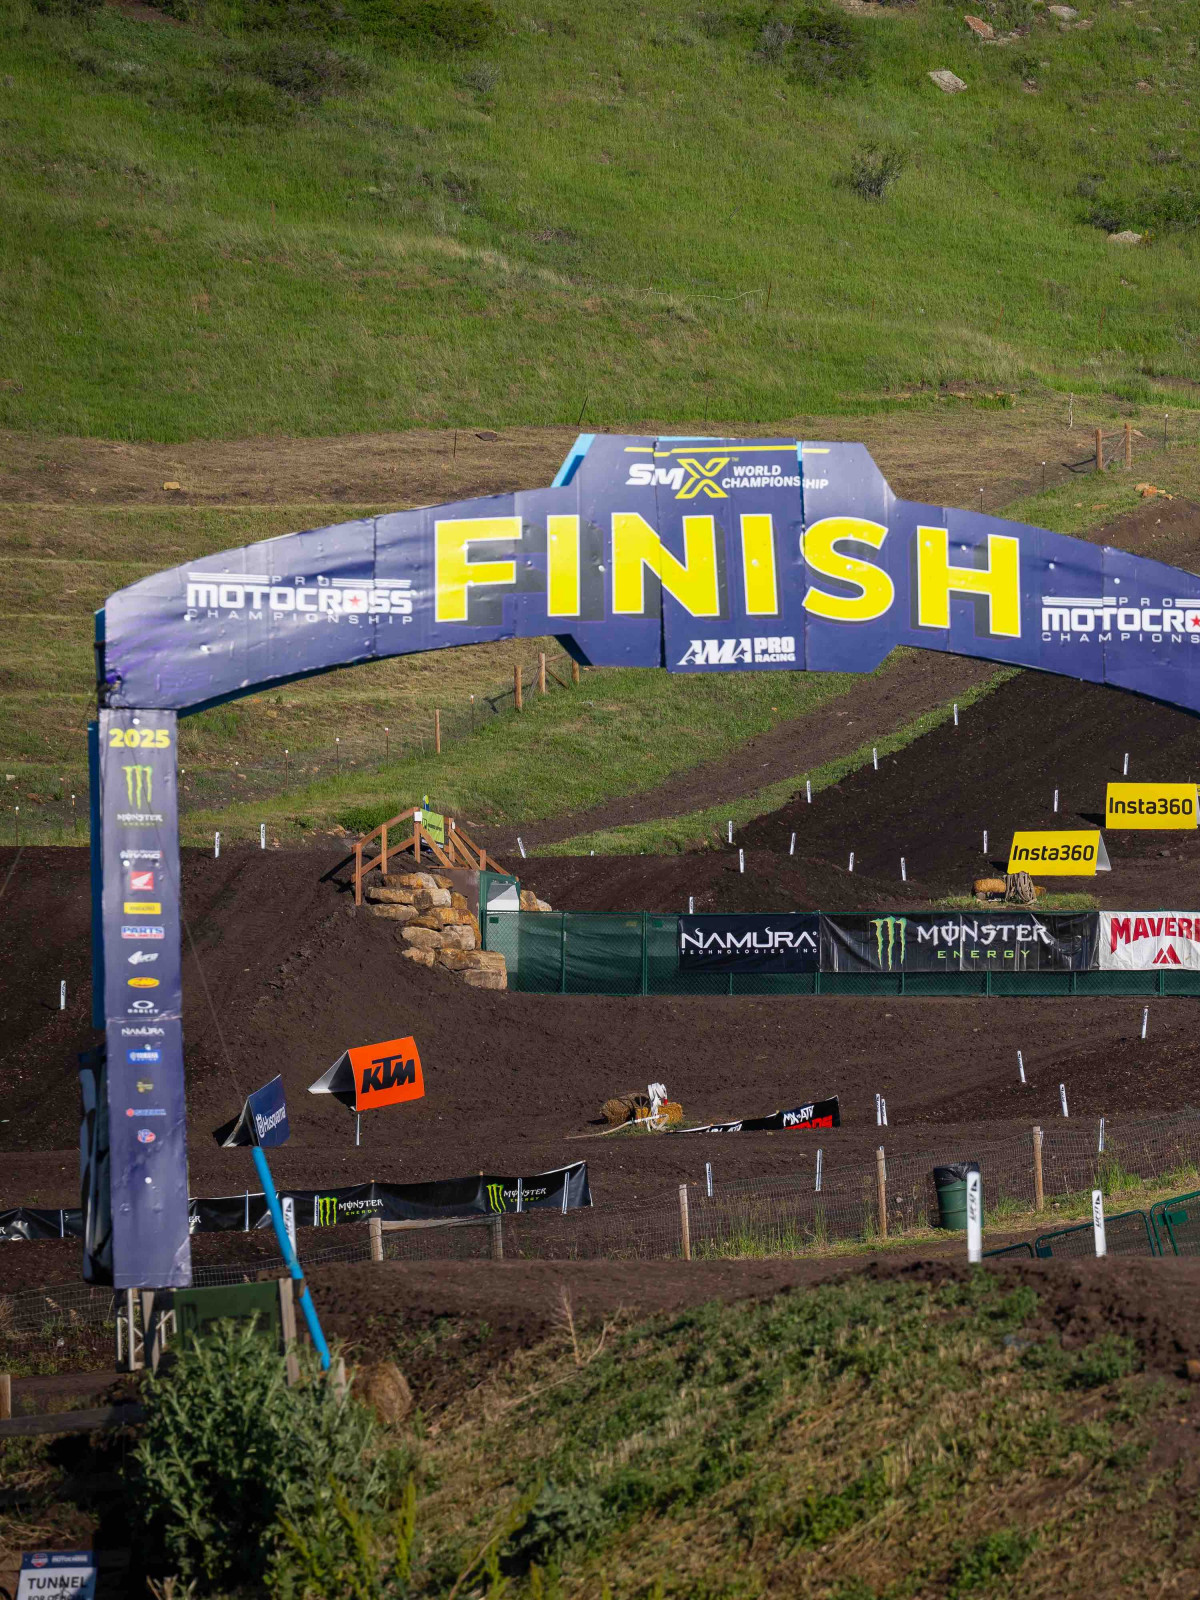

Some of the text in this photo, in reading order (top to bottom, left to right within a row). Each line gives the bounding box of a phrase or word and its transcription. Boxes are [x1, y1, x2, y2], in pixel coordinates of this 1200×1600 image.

[625, 457, 730, 499] SMX
[733, 465, 781, 477] WORLD
[722, 475, 829, 489] CHAMPIONSHIP
[271, 576, 331, 587] PRO
[434, 512, 1021, 639] FINISH
[187, 583, 413, 614] MOTOCROSS
[1118, 597, 1173, 608] PRO
[186, 609, 413, 624] CHAMPIONSHIP
[676, 638, 752, 666] AMA
[754, 636, 796, 654] PRO
[755, 653, 796, 663] RACING
[109, 728, 171, 749] 2025
[1109, 797, 1193, 815] Insta360
[117, 813, 163, 822] MONSTER
[1012, 845, 1094, 861] Insta360
[681, 927, 818, 949] NAMURA
[916, 920, 1054, 946] MONSTER
[937, 950, 1031, 960] ENERGY
[121, 1026, 165, 1036] NAMURA
[361, 1055, 416, 1094] KTM
[339, 1199, 384, 1211] MONSTER
[28, 1576, 87, 1590] TUNNEL
